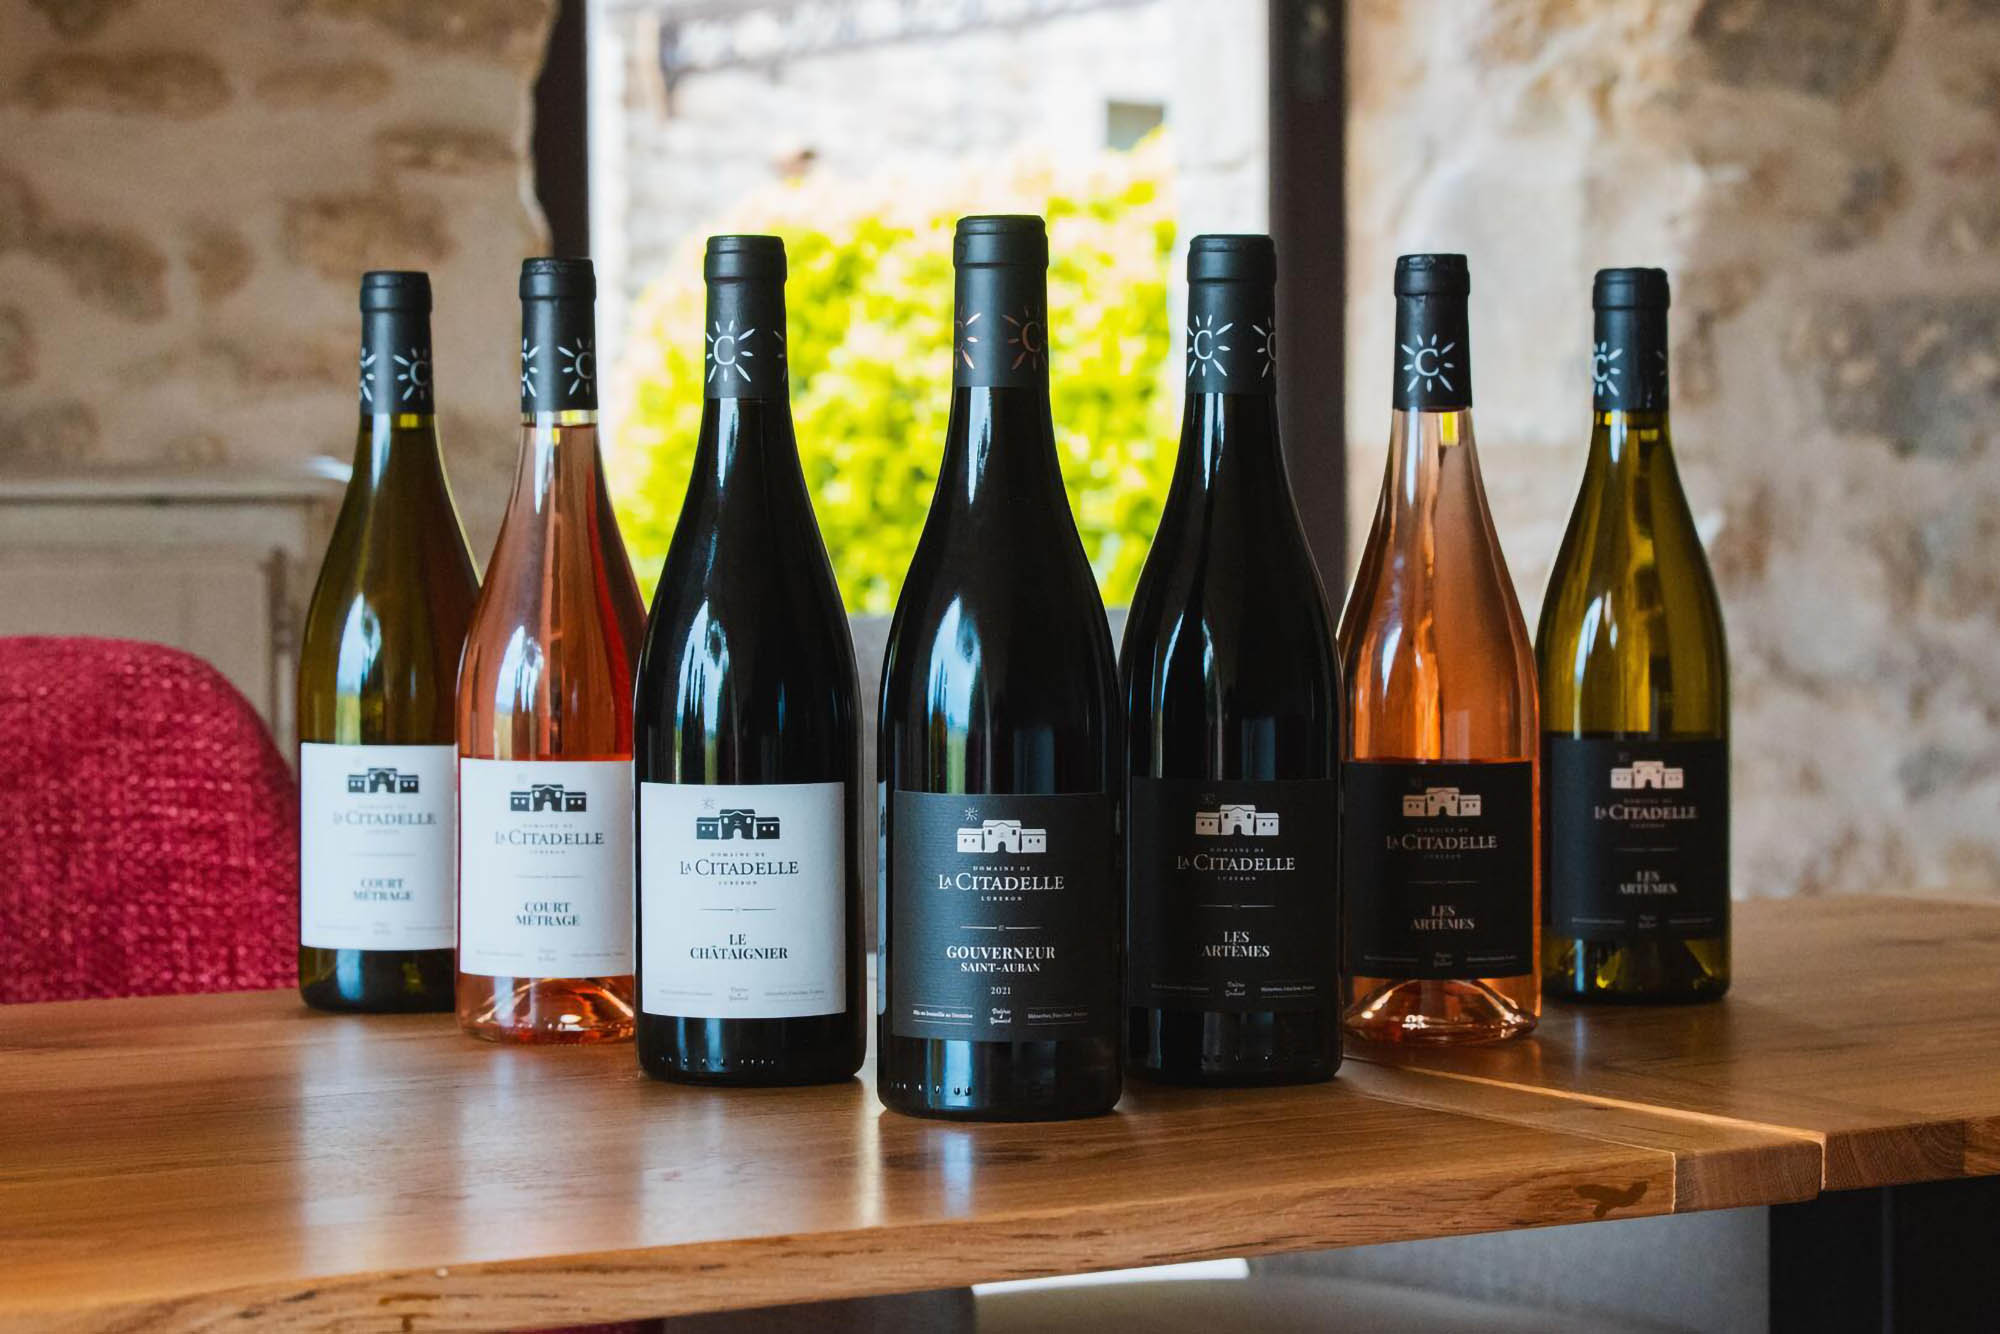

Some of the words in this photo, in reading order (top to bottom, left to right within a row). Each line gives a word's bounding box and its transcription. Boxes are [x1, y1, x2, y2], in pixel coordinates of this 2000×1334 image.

[713, 335, 736, 365] C
[1194, 329, 1213, 360] C
[1414, 348, 1439, 376] C
[344, 809, 436, 825] CITADELLE
[1609, 804, 1697, 820] CITADELLE
[507, 830, 605, 845] CITADELLE
[1402, 834, 1498, 849] CITADELLE
[695, 859, 799, 876] CITADELLE
[1193, 854, 1295, 871] CITADELLE
[361, 878, 404, 889] COURT
[939, 874, 952, 890] LA
[956, 872, 1064, 891] CITADELLE
[524, 902, 570, 913] COURT
[1431, 905, 1455, 917] LES
[515, 913, 580, 927] MÉTRAGE
[729, 934, 746, 945] LE
[1224, 931, 1249, 943] LES
[689, 945, 788, 960] CHÂTAIGNIER
[946, 945, 1056, 960] GOUVERNEUR
[1202, 943, 1271, 958] ARTÈMES
[960, 962, 1041, 973] SAINT-AUBAN
[990, 987, 1012, 995] 2021
